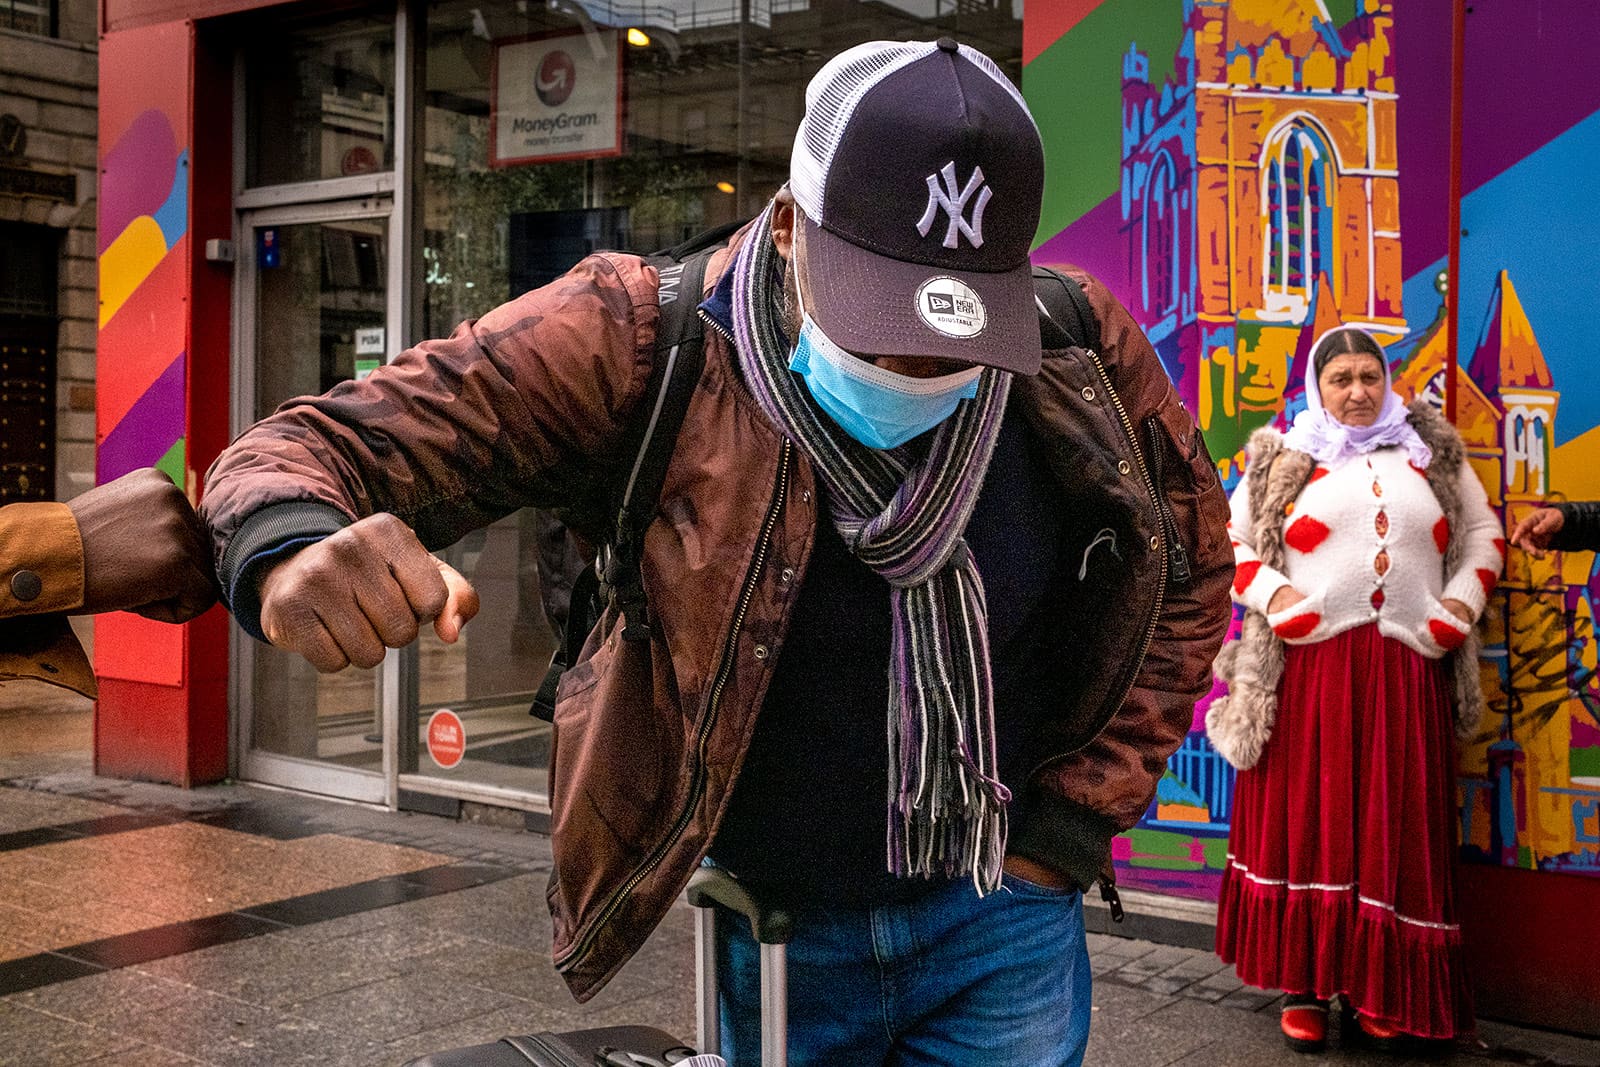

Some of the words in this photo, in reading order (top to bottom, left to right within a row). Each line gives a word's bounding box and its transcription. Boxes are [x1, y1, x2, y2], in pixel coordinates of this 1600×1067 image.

[512, 113, 597, 134] MoneyGram
[916, 161, 993, 249] NY
[955, 299, 974, 308] NEW
